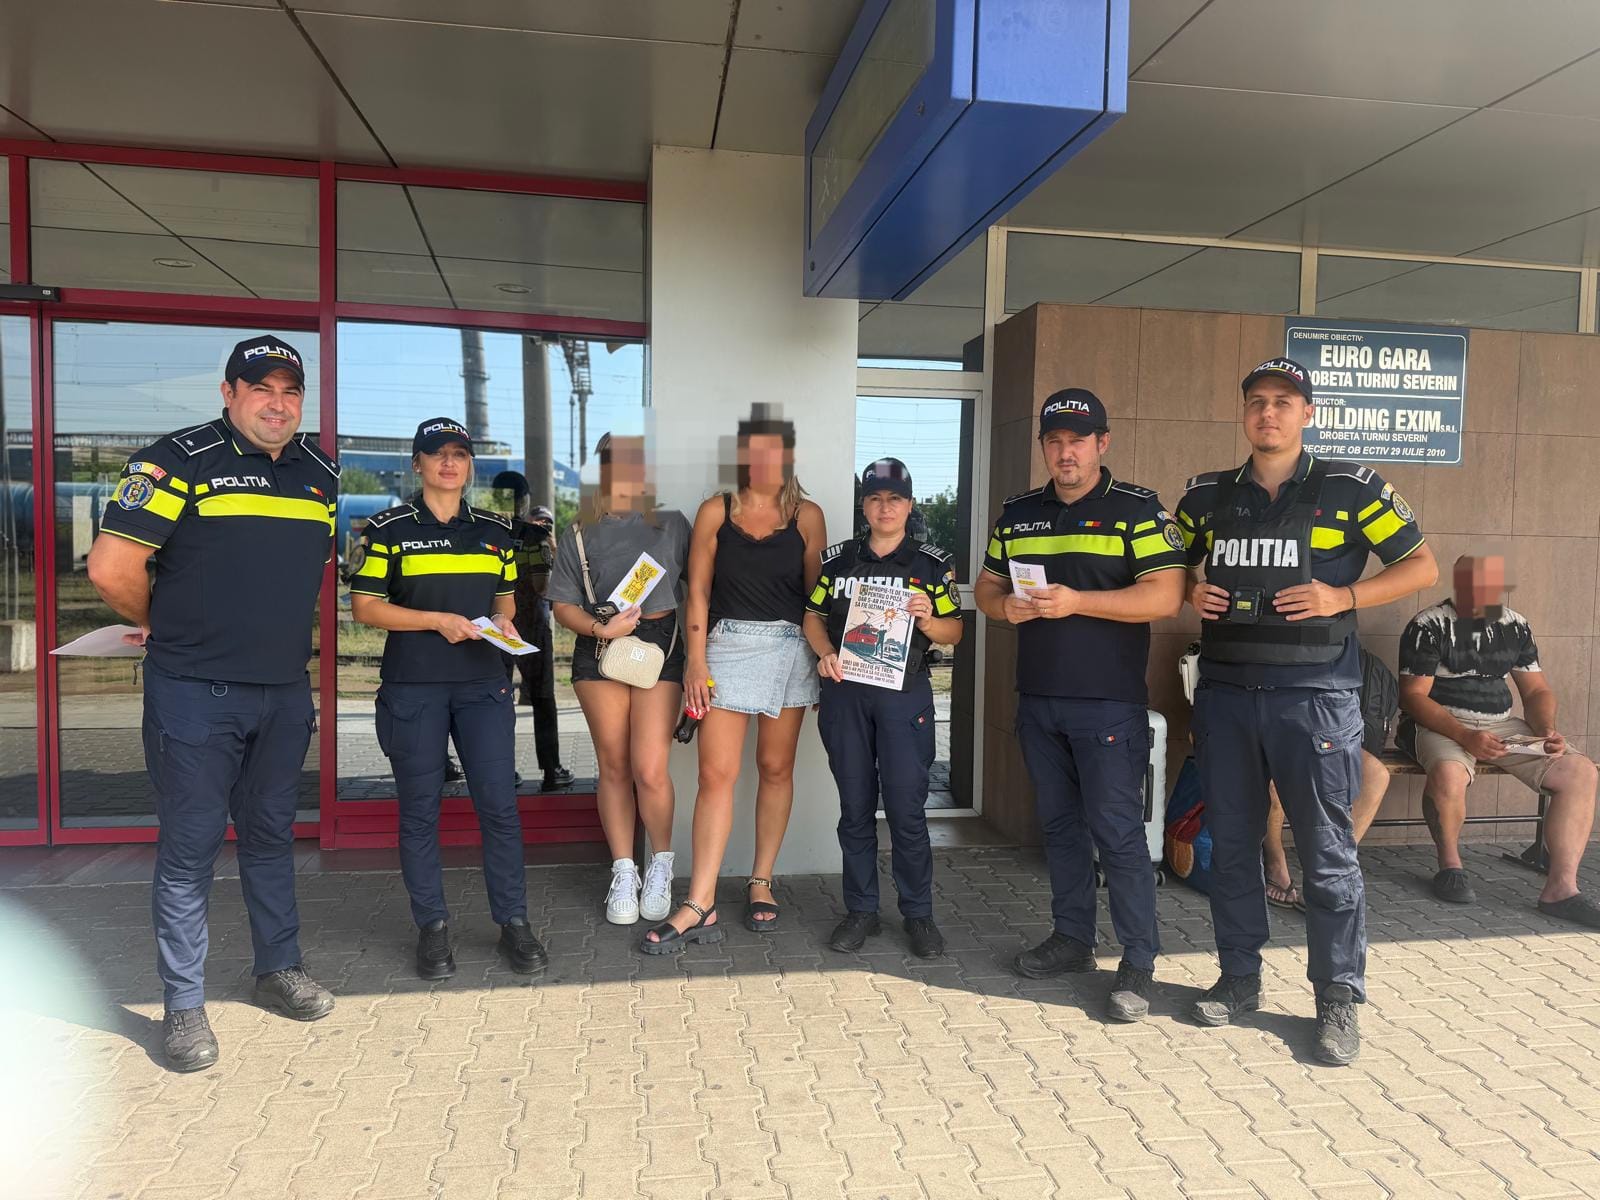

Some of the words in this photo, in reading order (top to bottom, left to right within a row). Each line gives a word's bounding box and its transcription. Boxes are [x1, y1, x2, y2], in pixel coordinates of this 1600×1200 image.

[1293, 332, 1329, 340] DENUMIRE
[1331, 334, 1364, 342] OBIECTIV:
[244, 345, 300, 366] POLITIA
[1320, 344, 1373, 369] EURO
[1379, 347, 1431, 371] GARA
[1308, 370, 1353, 387] OBETA
[1356, 372, 1400, 388] TURNU
[1403, 375, 1457, 391] SEVERIN
[1044, 400, 1090, 416] POLITIA
[1312, 397, 1346, 406] TRUCTOR:
[1395, 409, 1441, 432] EXIM
[423, 423, 470, 439] POLITIA
[1319, 431, 1361, 440] DROBETA
[1362, 432, 1391, 441] TURNU
[1392, 433, 1428, 443] SEVERIN
[1302, 444, 1347, 454] RECEPTIE
[1390, 447, 1401, 456] 29
[1402, 448, 1424, 456] IULIE
[1426, 448, 1446, 457] 2010
[210, 475, 271, 489] POLITIA
[1012, 520, 1052, 533] POLITIA
[401, 539, 452, 550] POLITIA
[1211, 538, 1299, 567] POLITIA
